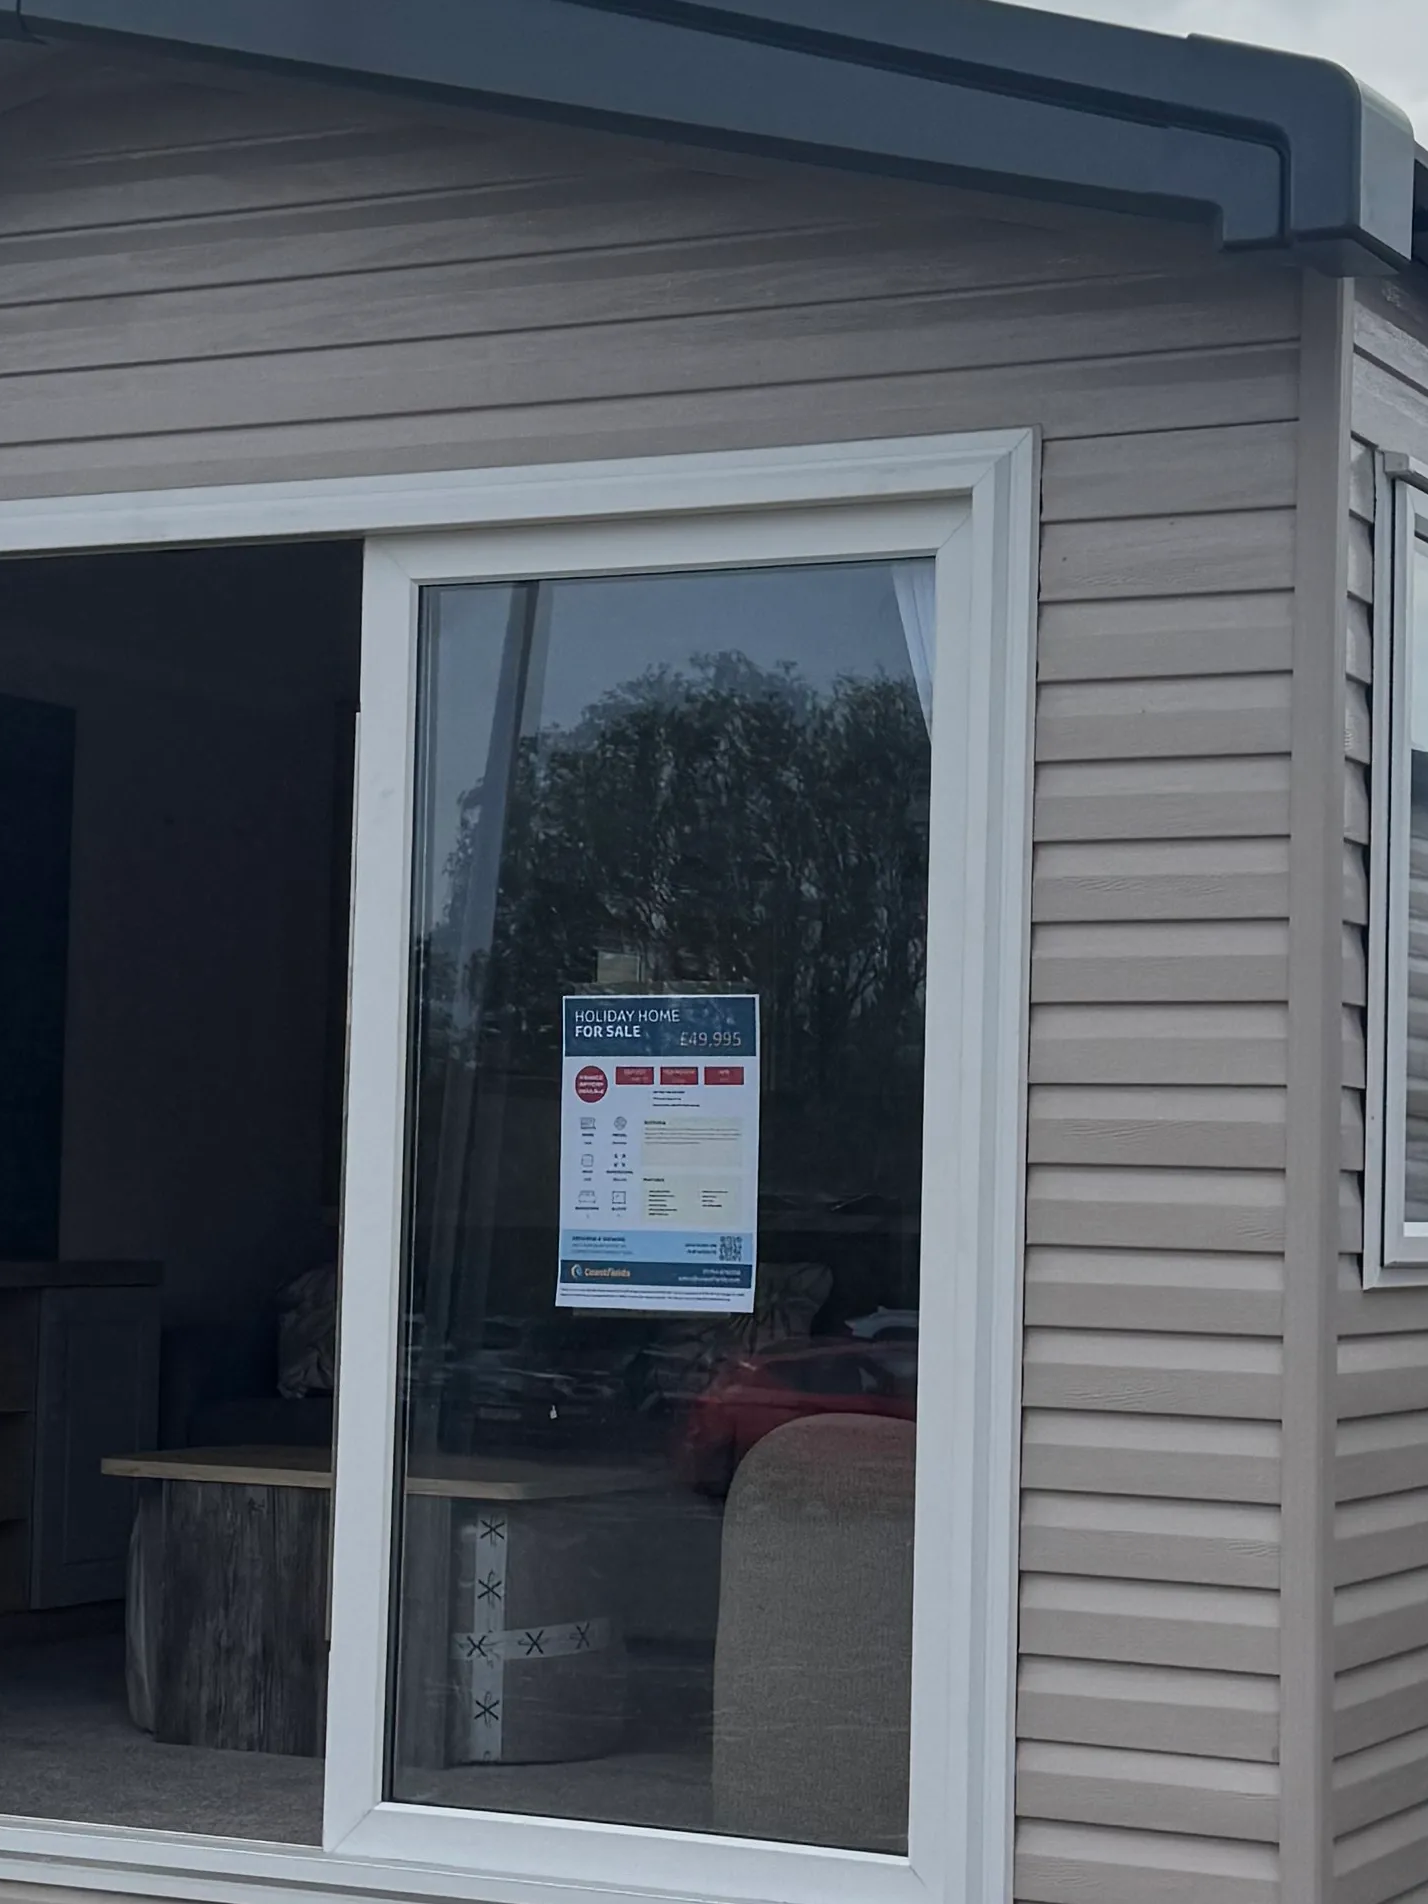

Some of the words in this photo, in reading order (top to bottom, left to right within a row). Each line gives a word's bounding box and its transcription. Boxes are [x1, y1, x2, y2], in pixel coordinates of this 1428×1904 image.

[575, 1009, 635, 1023] HOLIDAY
[638, 1009, 681, 1023] HOME
[575, 1025, 603, 1038] FOR
[606, 1025, 641, 1038] SALE
